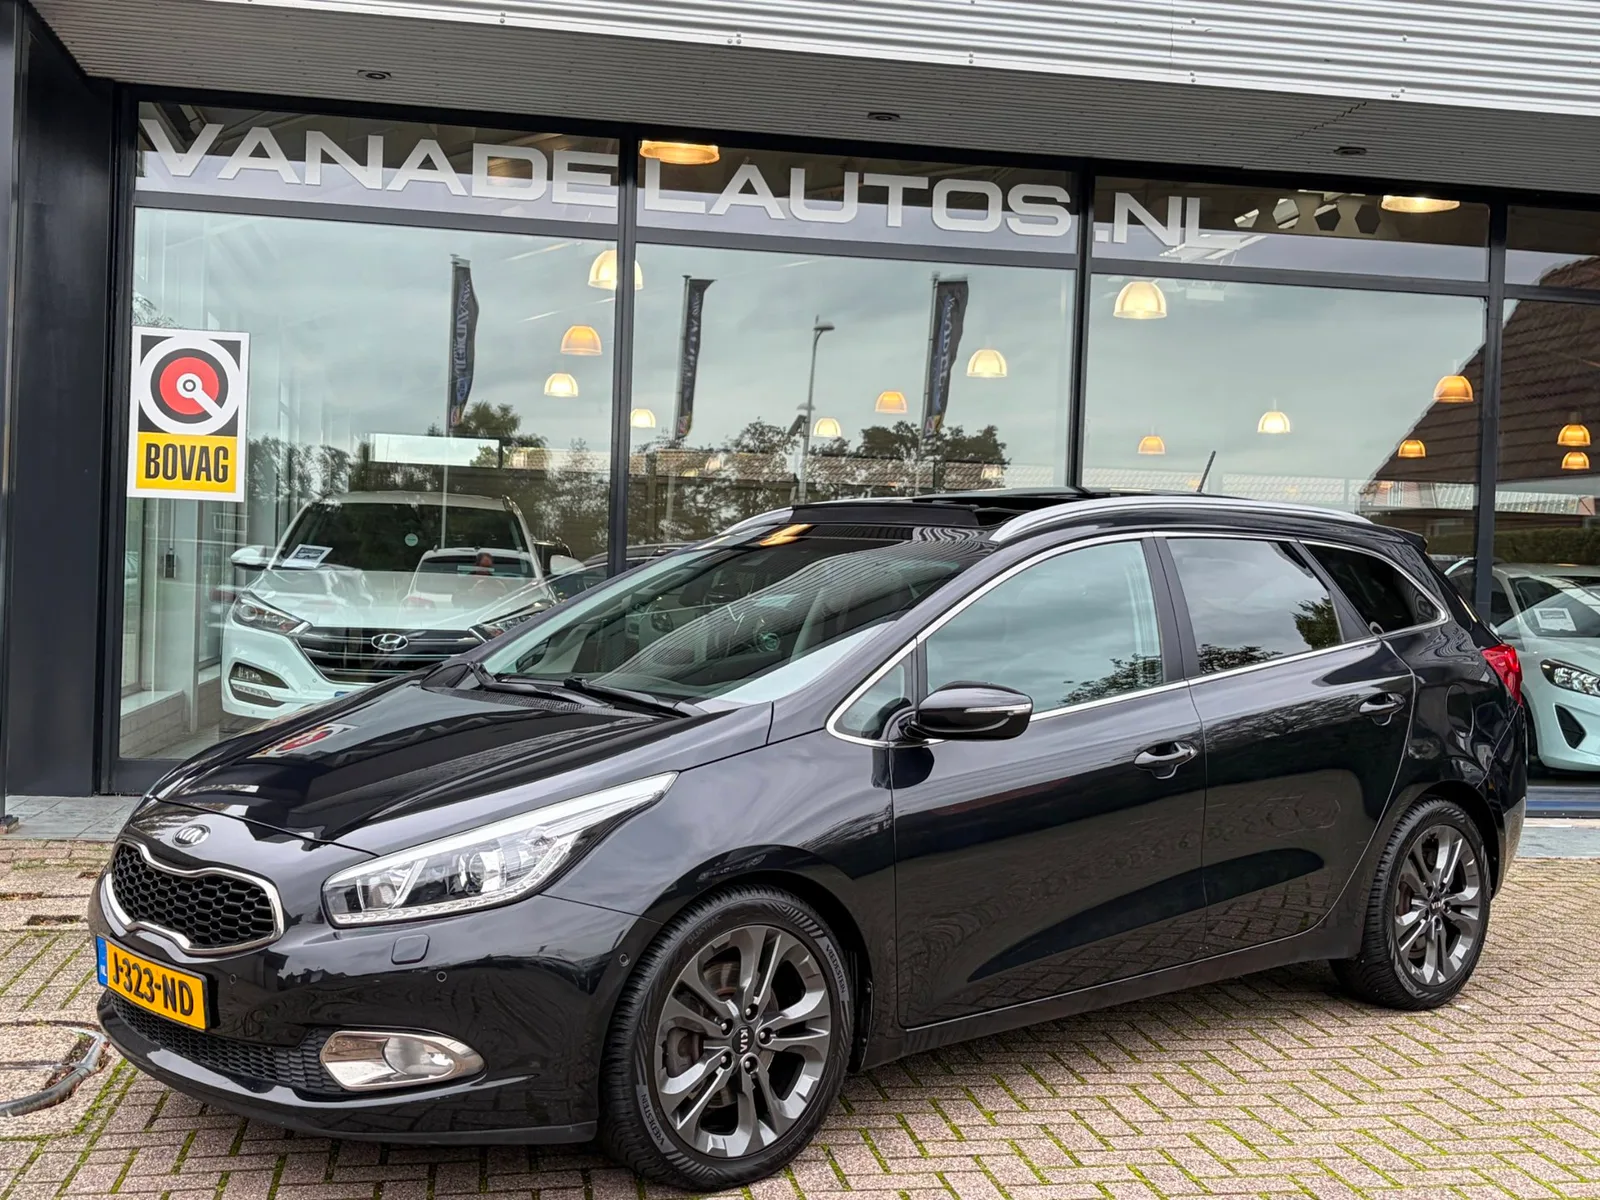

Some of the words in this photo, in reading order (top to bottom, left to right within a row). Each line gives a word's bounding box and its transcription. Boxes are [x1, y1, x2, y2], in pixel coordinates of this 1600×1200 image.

[145, 442, 230, 483] BOVAG
[175, 828, 202, 843] KIA
[113, 952, 194, 1017] J-323-ND
[740, 1029, 749, 1053] KIA
[640, 1093, 666, 1146] VREDESTEIN
